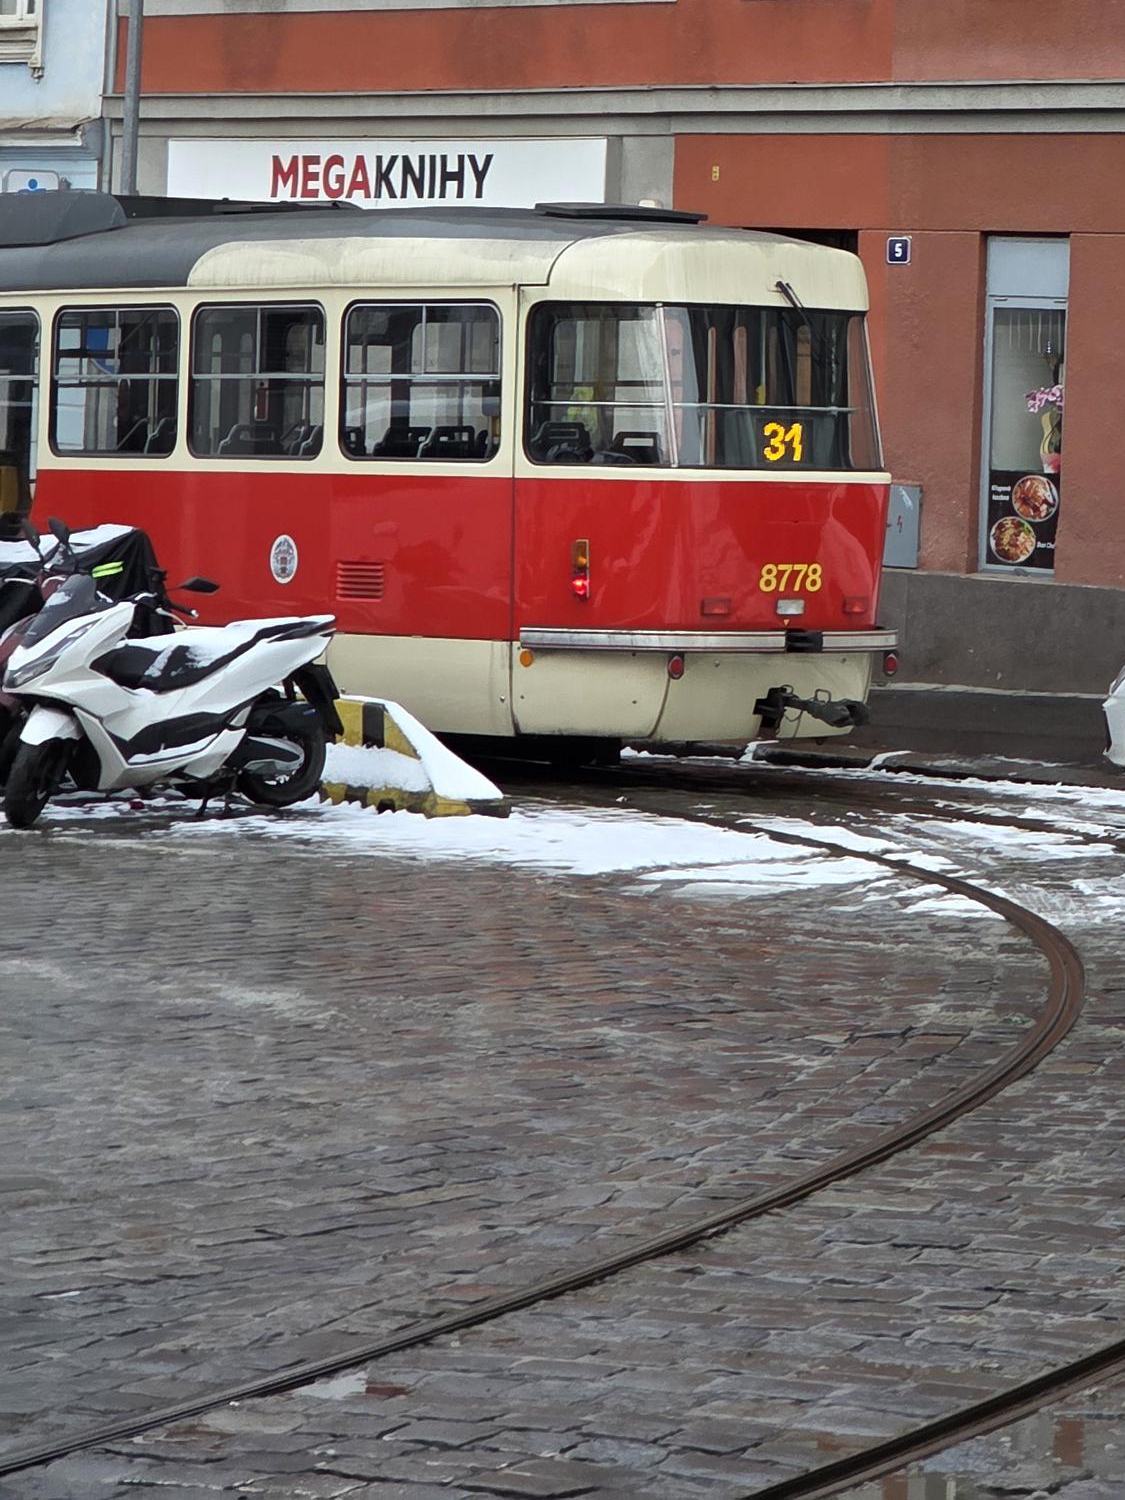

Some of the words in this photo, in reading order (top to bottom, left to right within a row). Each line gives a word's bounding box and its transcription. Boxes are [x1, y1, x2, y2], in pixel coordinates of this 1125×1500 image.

[270, 154, 494, 199] MEGAKNIHY
[894, 242, 903, 258] 5
[763, 422, 803, 462] 31
[759, 563, 822, 592] 8778
